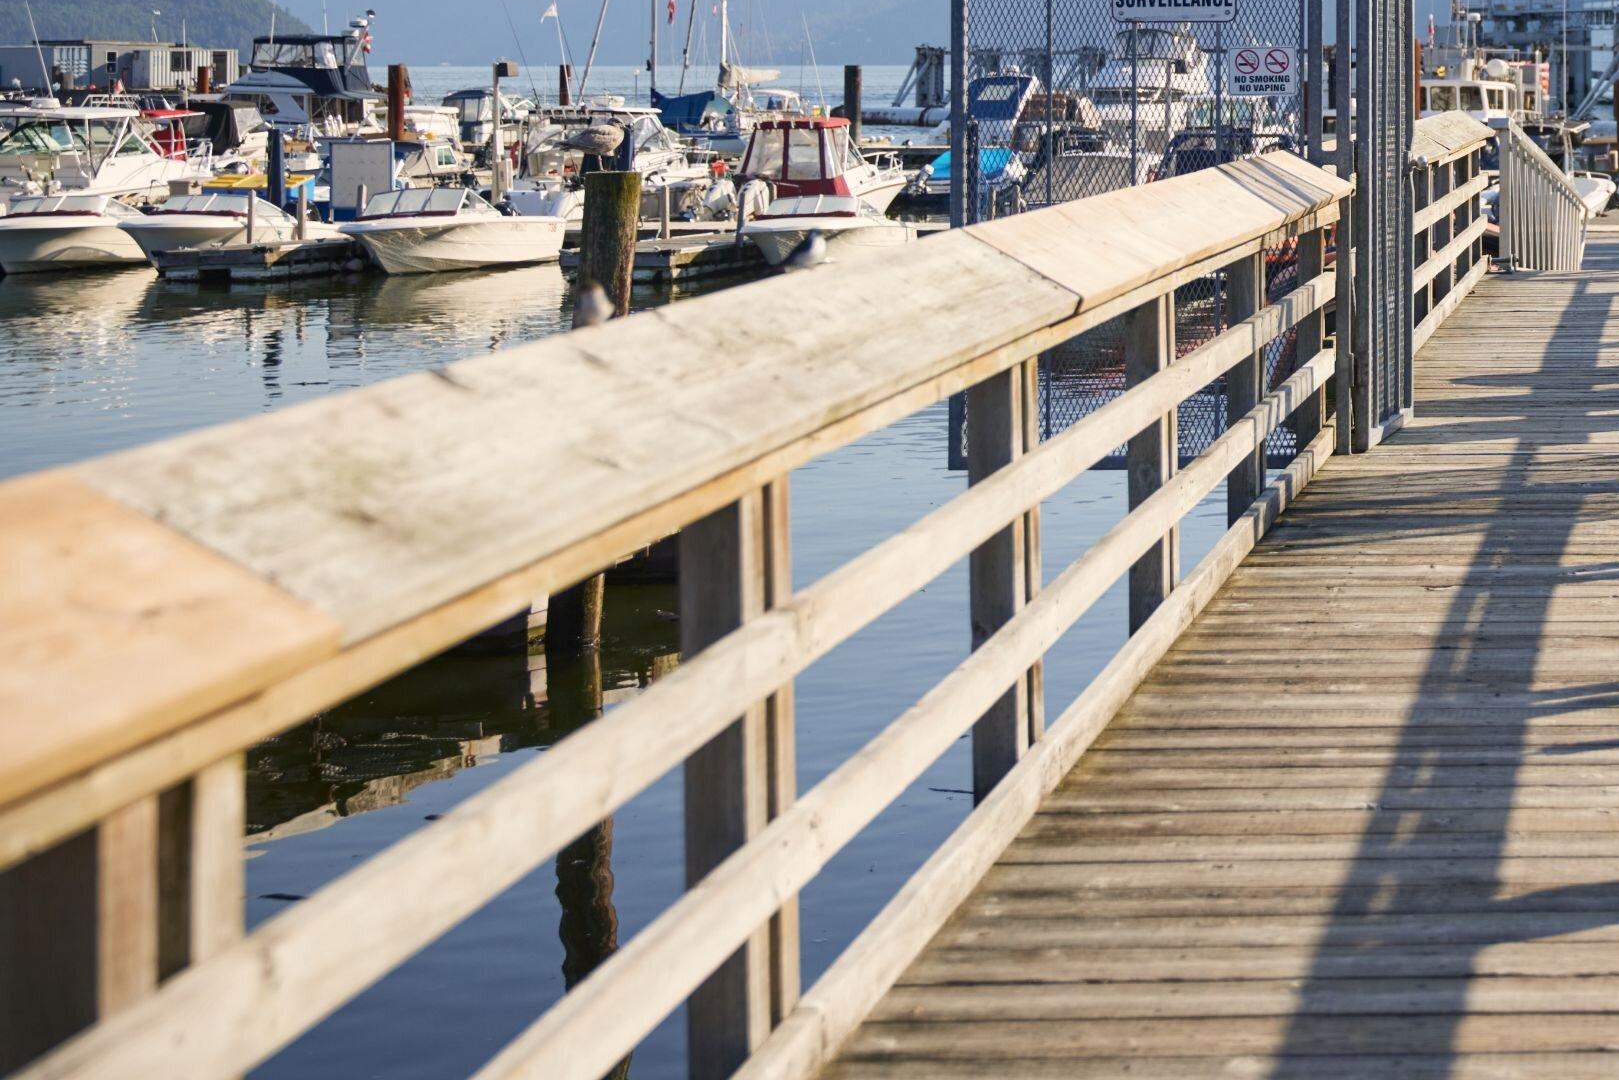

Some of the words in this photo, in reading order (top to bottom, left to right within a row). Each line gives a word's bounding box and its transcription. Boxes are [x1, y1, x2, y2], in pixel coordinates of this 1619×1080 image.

[1234, 75, 1247, 84] NO
[1249, 75, 1291, 84] SMOKING
[1239, 84, 1251, 92] NO
[1254, 84, 1286, 92] VAPING
